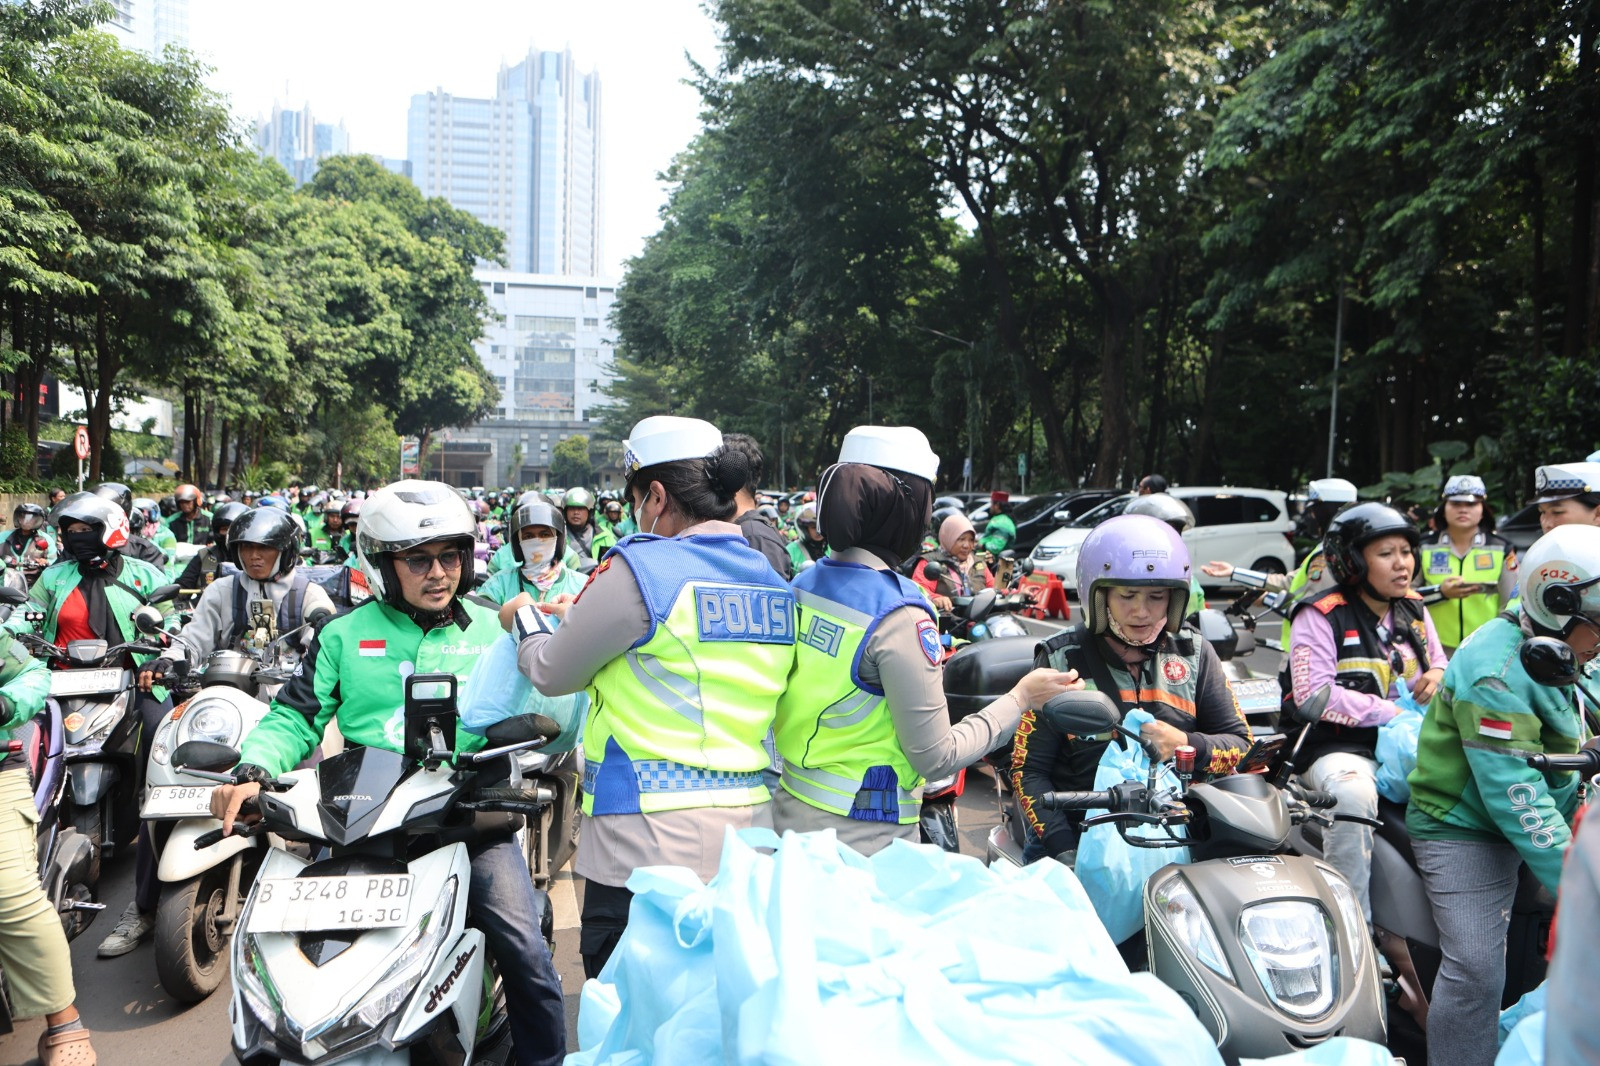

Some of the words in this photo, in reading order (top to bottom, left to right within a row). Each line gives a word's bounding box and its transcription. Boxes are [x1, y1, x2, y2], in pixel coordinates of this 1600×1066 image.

[701, 592, 793, 638] POLISI
[152, 789, 162, 800] B
[169, 787, 206, 799] 5882
[333, 794, 373, 802] HONDA
[1507, 783, 1556, 849] Grab
[1232, 856, 1278, 865] Independent
[259, 883, 274, 904] B
[289, 880, 348, 901] 3248
[366, 877, 410, 900] PBD
[424, 944, 477, 1013] Honda
